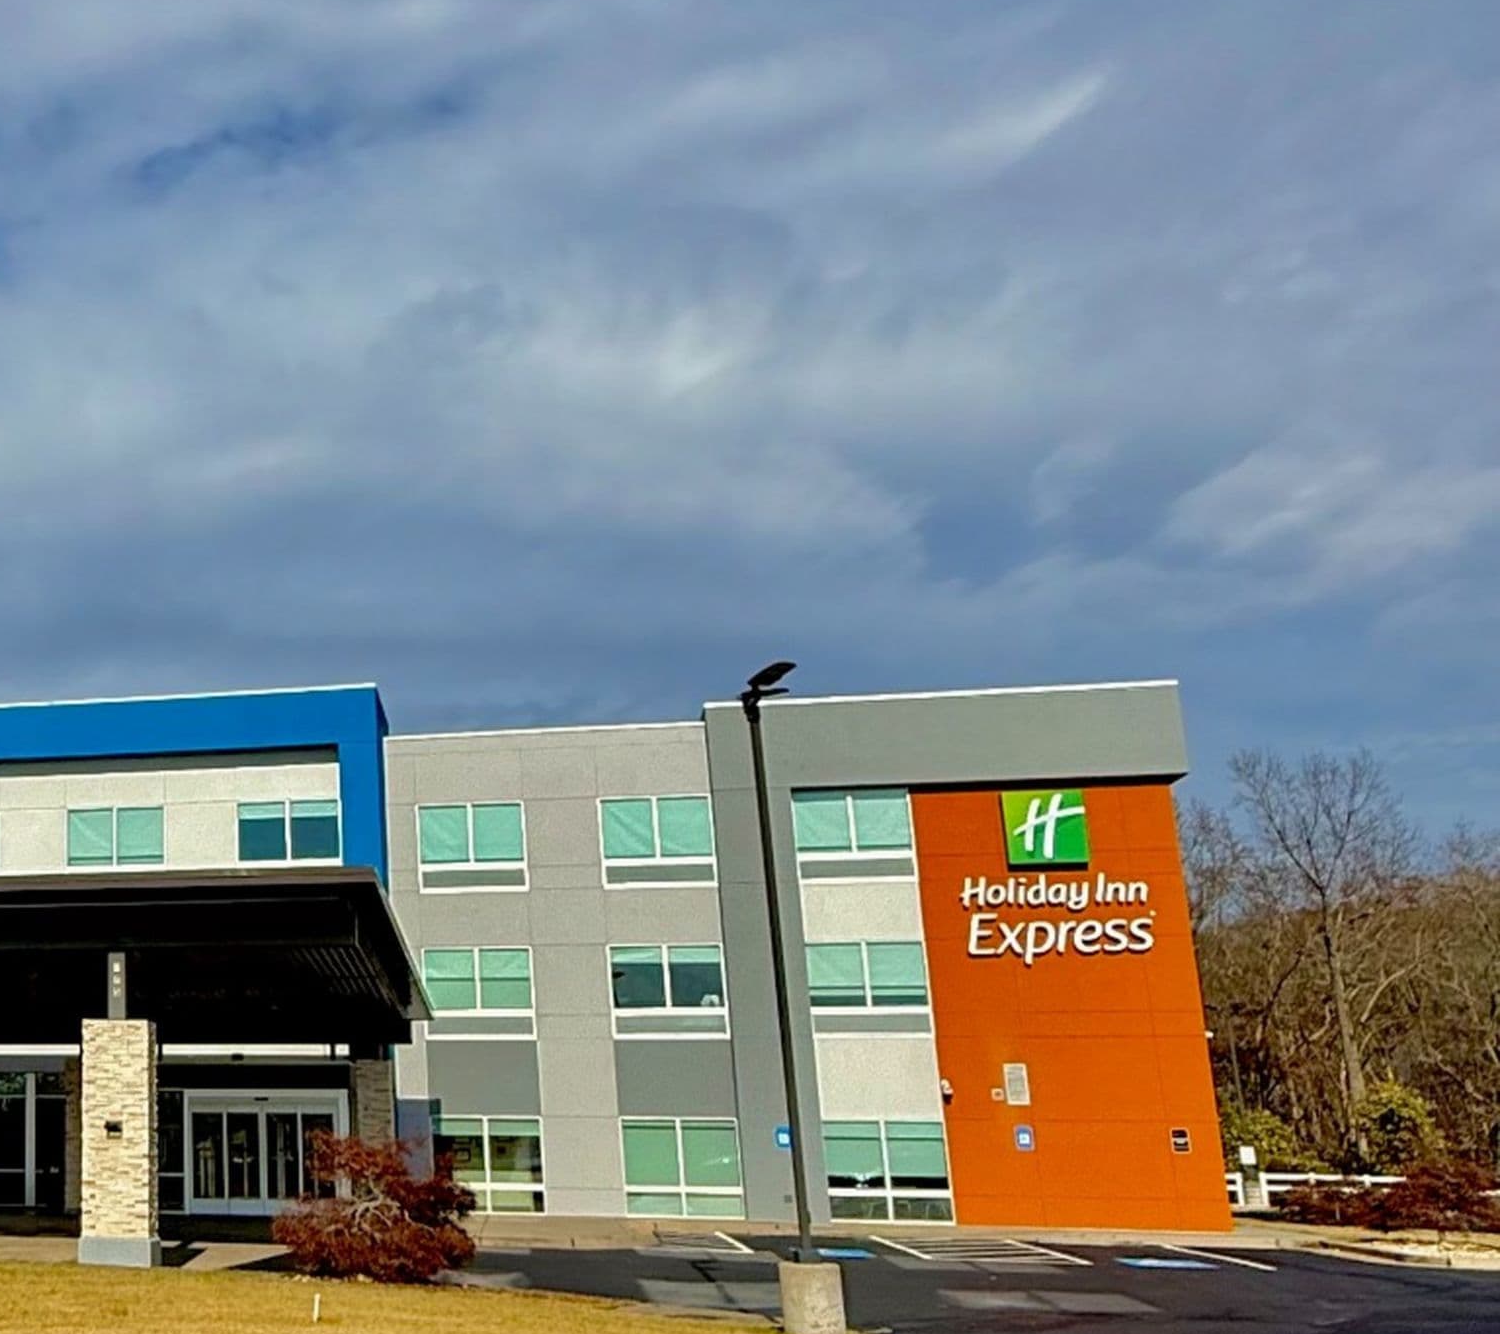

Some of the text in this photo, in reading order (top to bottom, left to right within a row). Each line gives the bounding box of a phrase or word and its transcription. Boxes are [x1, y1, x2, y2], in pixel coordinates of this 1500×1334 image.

[960, 871, 1149, 910] Holiday Inn
[967, 912, 1155, 965] Express
